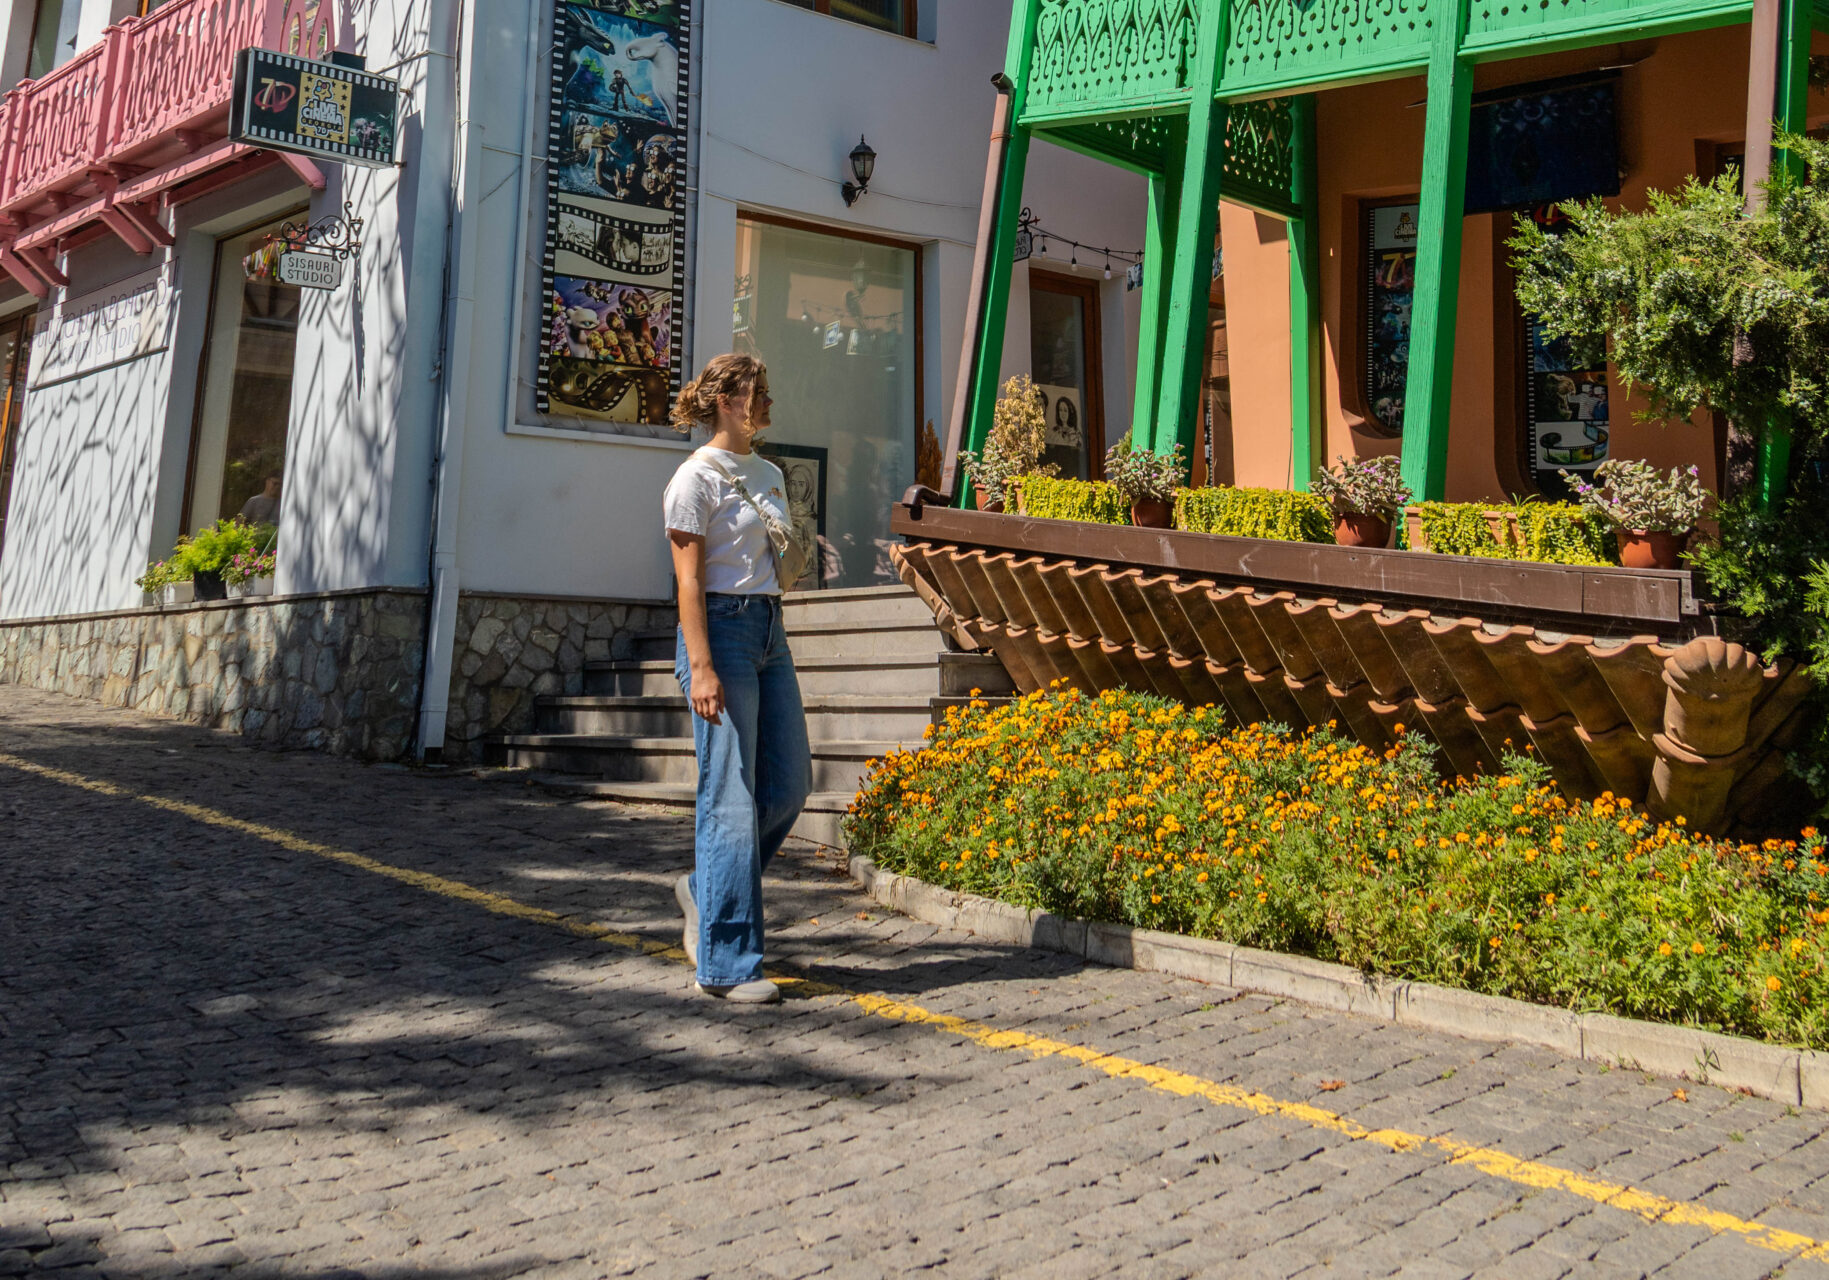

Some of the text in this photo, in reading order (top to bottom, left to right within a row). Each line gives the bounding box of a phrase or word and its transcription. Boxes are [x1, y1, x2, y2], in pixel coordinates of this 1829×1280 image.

[254, 77, 296, 113] 7D
[313, 99, 337, 113] LIVE
[302, 106, 342, 125] CINEMA
[301, 117, 342, 131] GEORGIA
[317, 126, 327, 134] 7D
[287, 256, 335, 273] SISAURI
[287, 269, 333, 285] STUDIO
[95, 320, 142, 355] STUDIO
